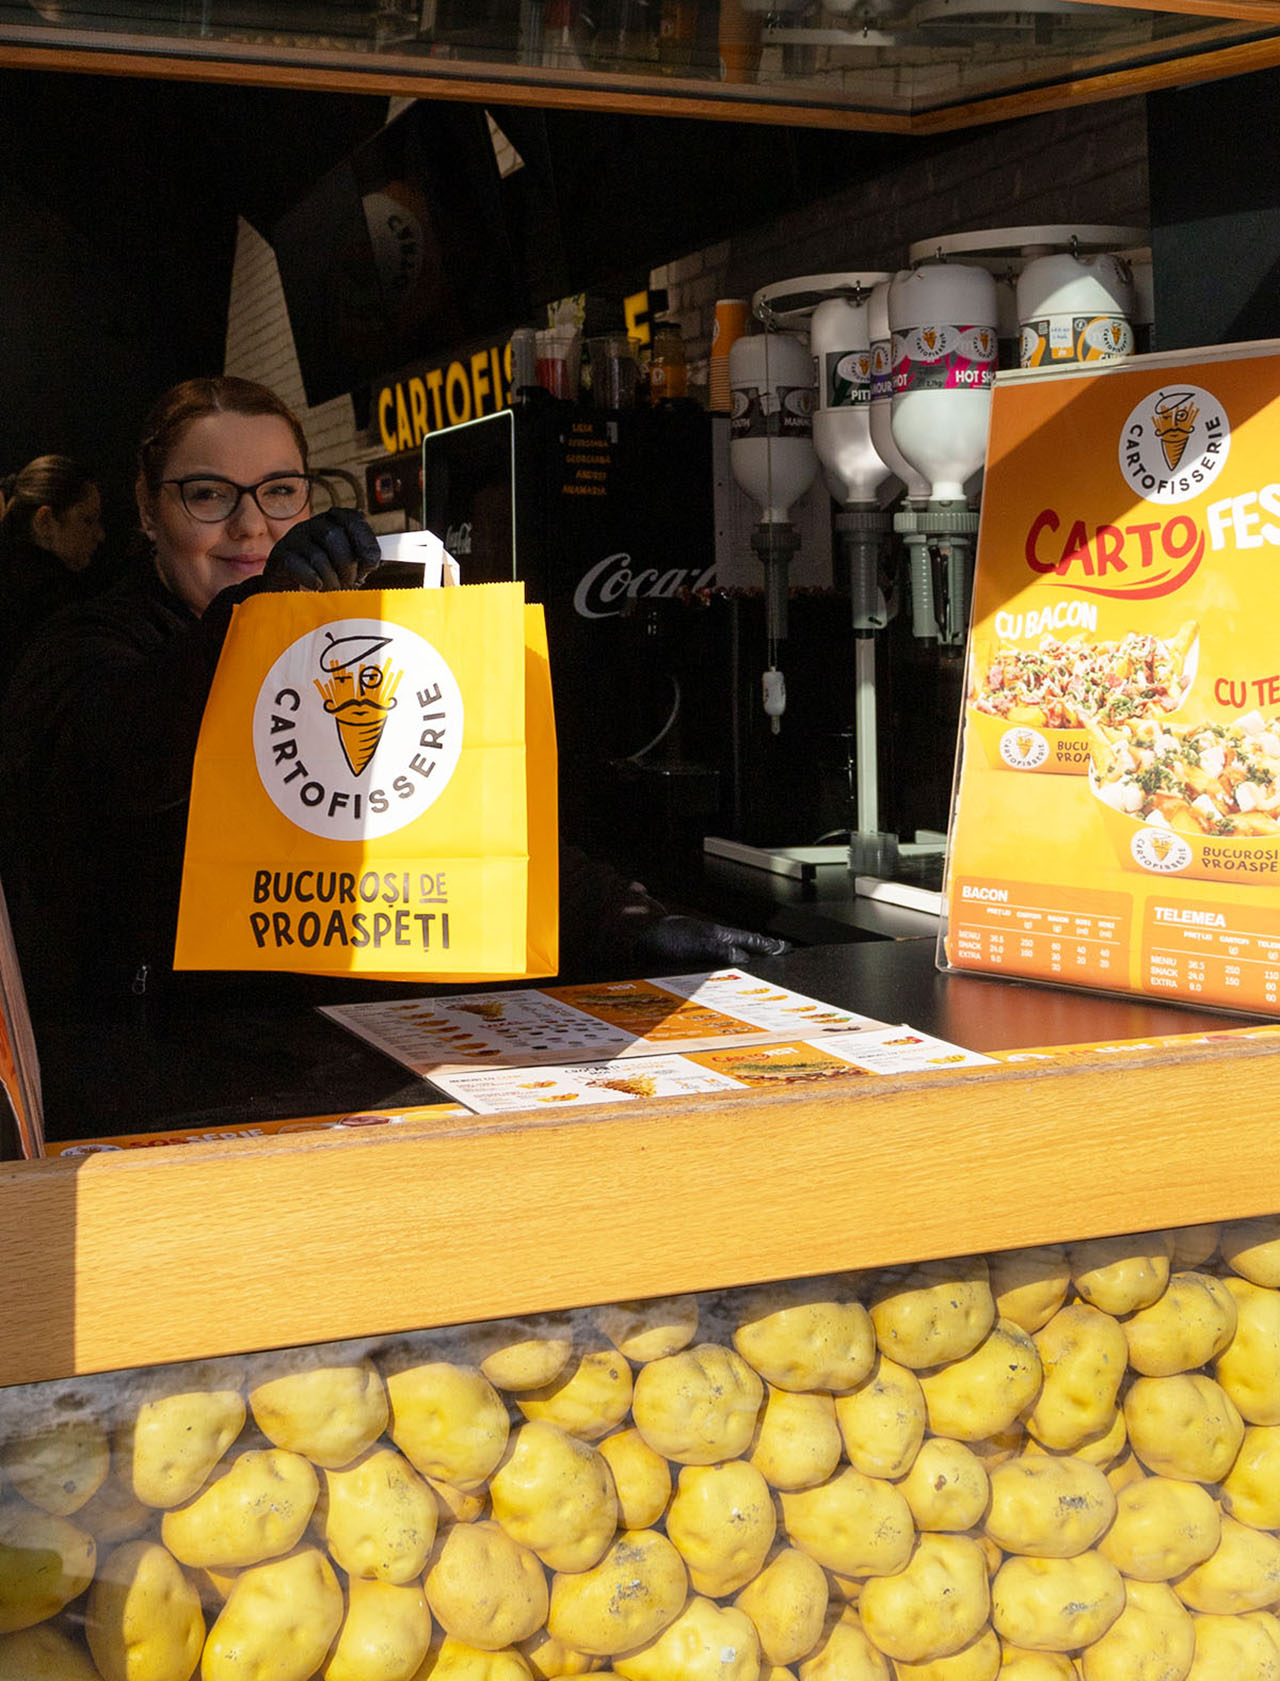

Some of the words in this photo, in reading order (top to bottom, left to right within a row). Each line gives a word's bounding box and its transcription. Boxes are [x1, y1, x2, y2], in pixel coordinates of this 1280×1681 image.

[955, 370, 979, 383] HOT
[1126, 415, 1222, 495] CARTOFISSERIE
[995, 611, 1023, 640] CU
[1025, 601, 1097, 639] BACON
[1214, 677, 1247, 709] CU
[1251, 675, 1280, 707] TE
[270, 682, 446, 819] CARTOFISSERIE
[1057, 741, 1089, 751] BUCU
[420, 872, 448, 897] DE
[962, 885, 1009, 902] BACON
[1154, 906, 1226, 928] TELEMEA
[958, 950, 982, 960] EXTRA
[1150, 977, 1178, 988] EXTRA
